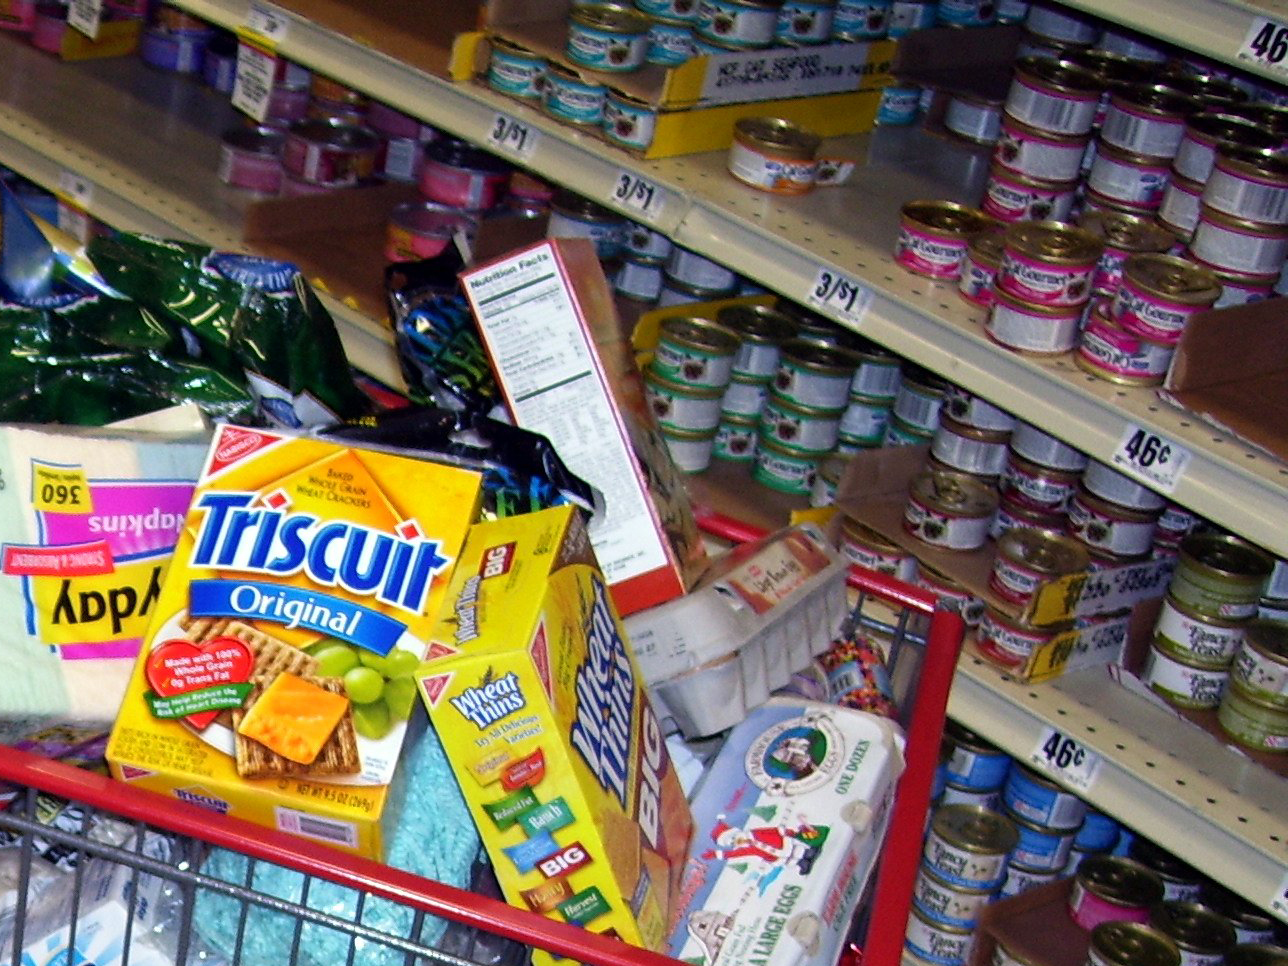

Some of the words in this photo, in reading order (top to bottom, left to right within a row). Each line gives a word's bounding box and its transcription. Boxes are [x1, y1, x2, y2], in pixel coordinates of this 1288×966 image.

[493, 117, 527, 150] 3/$1
[616, 175, 654, 210] 3/$1
[471, 263, 518, 288] Nutrition
[519, 254, 549, 271] Facts
[815, 270, 860, 313] 3/$1
[218, 434, 260, 460] NABISCO
[308, 475, 338, 491] WHOLE
[339, 481, 367, 497] GRAIN
[326, 467, 355, 482] BAKED
[41, 484, 82, 506] 360
[296, 485, 324, 500] WHEAT
[326, 490, 372, 509] CRACKERS
[193, 494, 448, 613] Triscuit
[483, 545, 509, 579] BIG
[52, 566, 163, 634] yday
[230, 585, 362, 636] Original
[165, 657, 191, 668] Made
[192, 653, 213, 663] with
[216, 649, 241, 660] 100%
[174, 665, 205, 676] Whole
[214, 671, 229, 680] Fat
[450, 672, 519, 720] Wheat
[571, 572, 615, 793] Wheat
[469, 691, 526, 731] Thins
[599, 640, 634, 810] Thins
[638, 705, 662, 850] BIG
[835, 770, 852, 795] ONE
[847, 738, 871, 772] DOZEN
[539, 846, 586, 878] BIG
[756, 914, 786, 956] LARGE
[773, 883, 803, 917] EGGS
